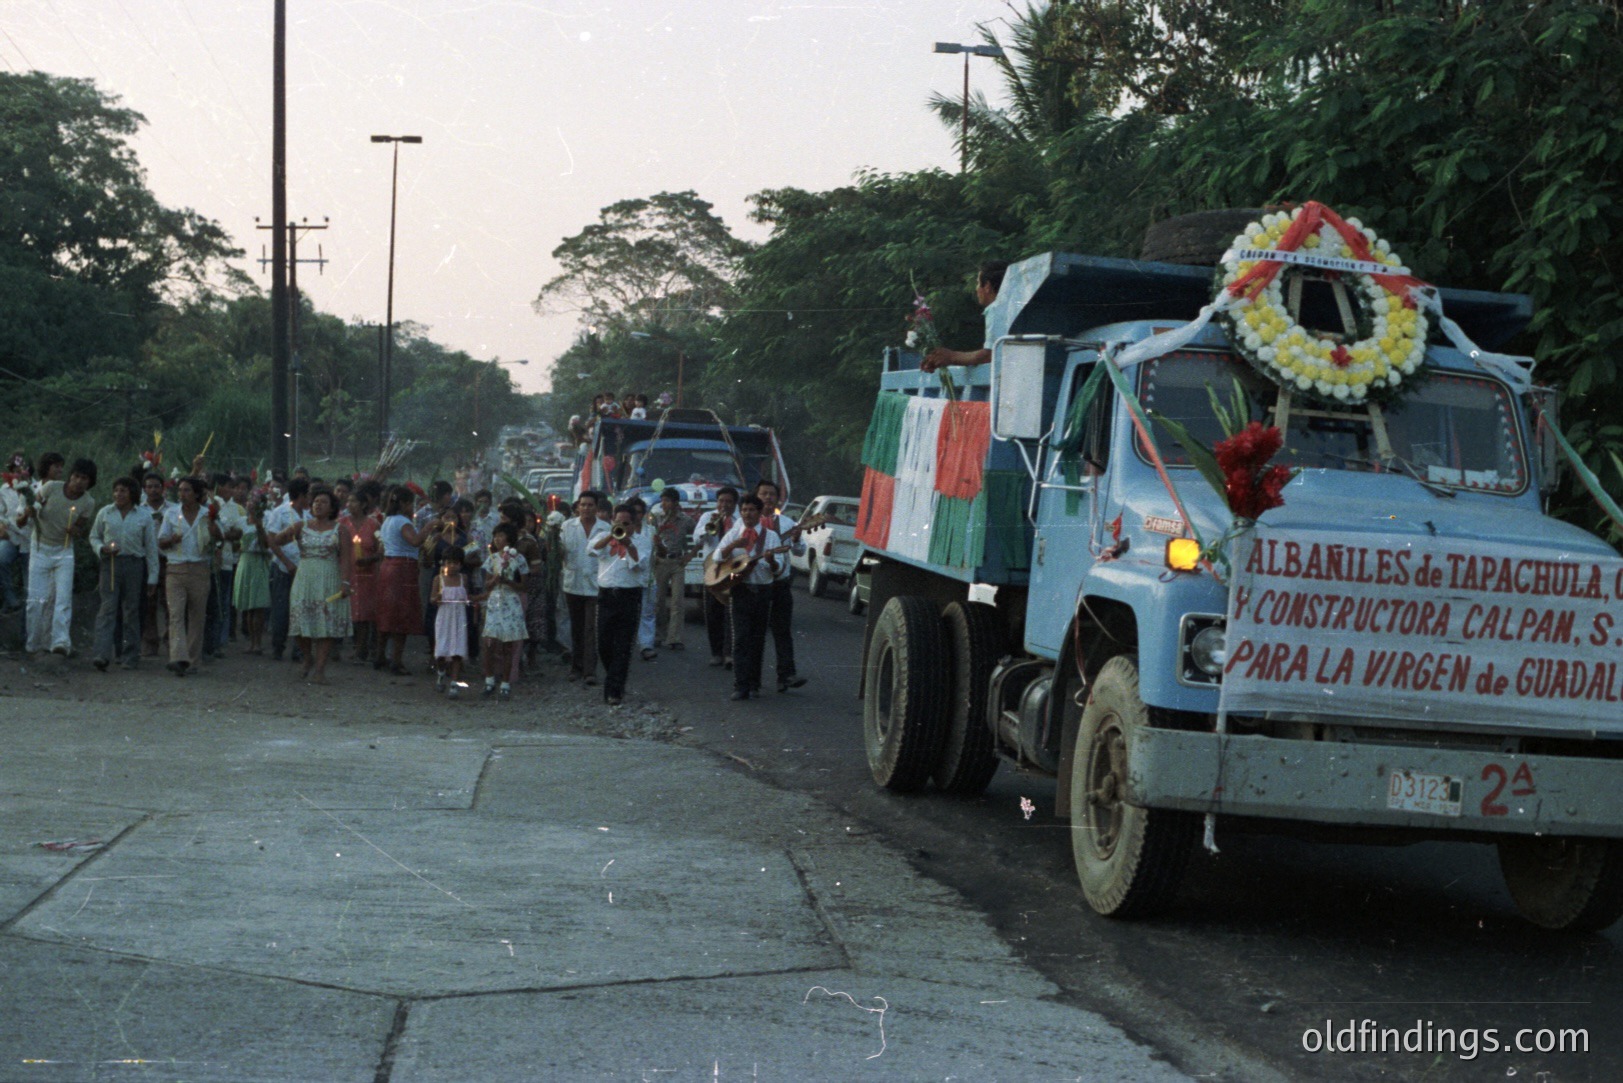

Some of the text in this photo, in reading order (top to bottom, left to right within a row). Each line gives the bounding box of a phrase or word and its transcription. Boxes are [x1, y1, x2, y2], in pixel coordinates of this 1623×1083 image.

[1246, 538, 1411, 587] ALBAÑILES
[1415, 555, 1443, 588] de
[1448, 554, 1610, 603] TAPACHULA,
[1234, 586, 1254, 620] Y
[1253, 590, 1450, 637] CONSTRUCTORA
[1463, 604, 1580, 647] CALPAN,
[1224, 640, 1623, 703] PARA LA VIRGEN de GUADAL
